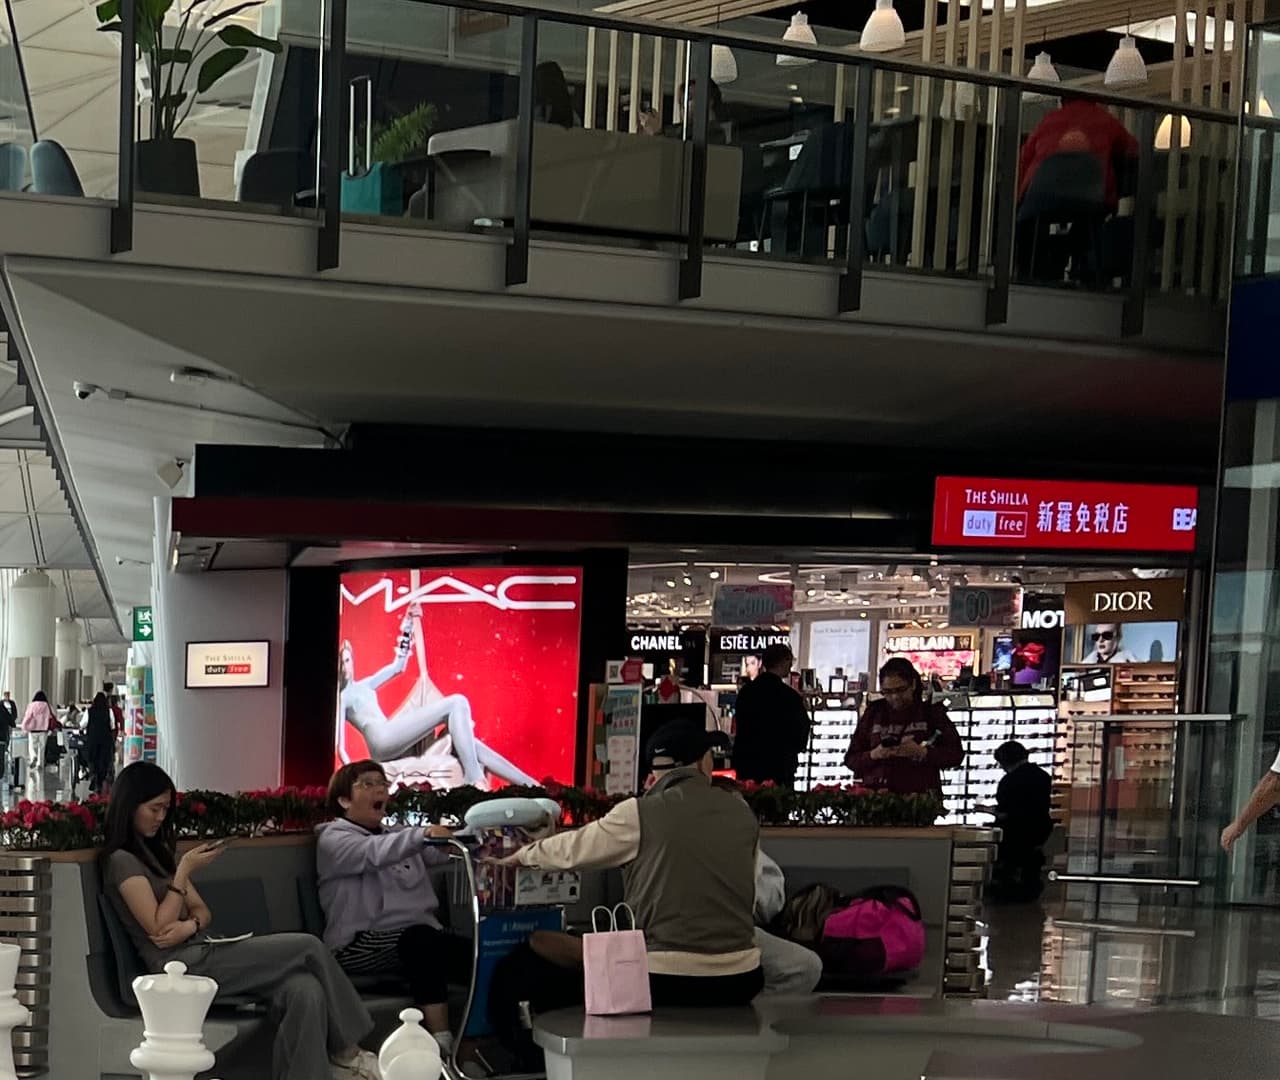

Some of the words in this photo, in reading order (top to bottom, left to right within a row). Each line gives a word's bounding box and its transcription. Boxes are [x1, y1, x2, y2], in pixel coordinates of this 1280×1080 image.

[965, 489, 987, 504] THE
[989, 489, 1029, 506] SHILLA
[967, 514, 992, 533] duty
[998, 515, 1024, 532] free
[1094, 591, 1153, 612] DIOR
[630, 635, 683, 651] CHANEL
[720, 633, 749, 650] ESTÉE
[885, 635, 955, 652] UERLAIN
[206, 665, 226, 674] duty
